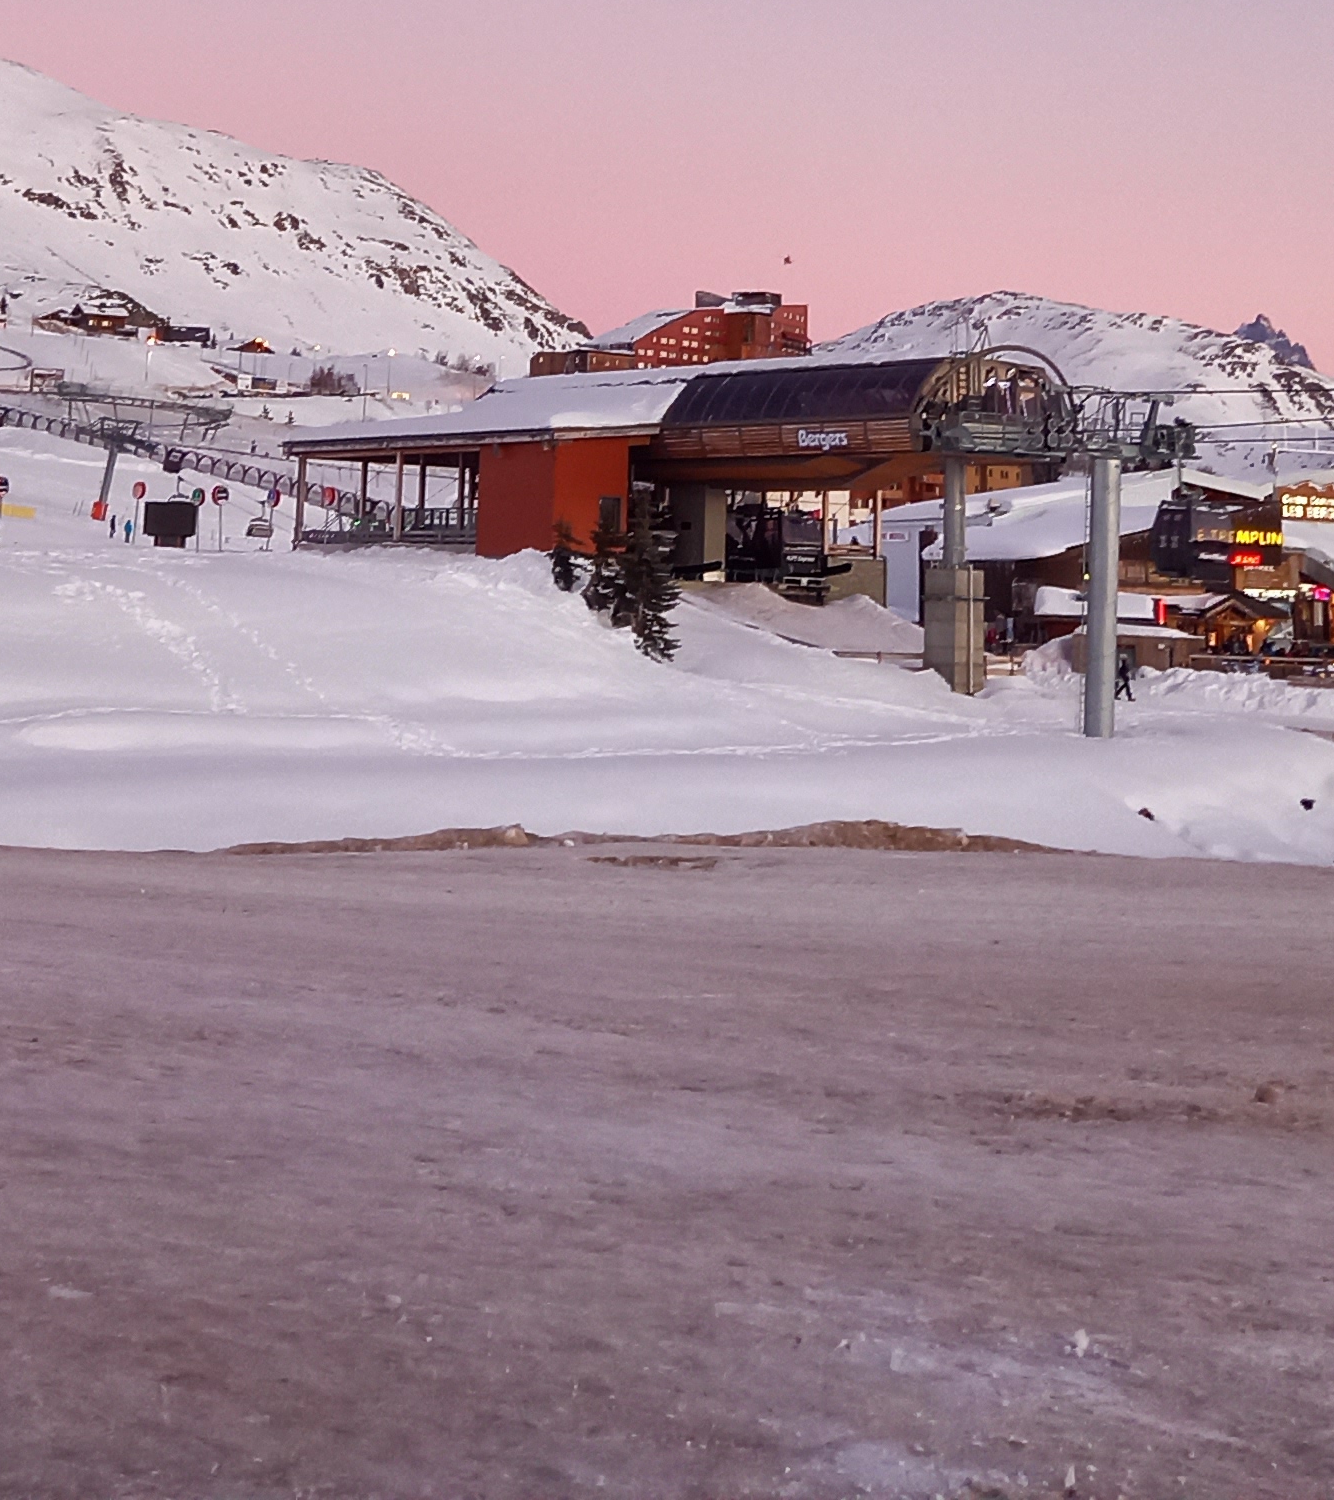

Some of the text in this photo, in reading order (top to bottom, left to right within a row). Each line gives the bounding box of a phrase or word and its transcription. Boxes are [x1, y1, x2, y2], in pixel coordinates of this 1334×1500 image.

[798, 429, 848, 451] Bergers
[1282, 504, 1304, 518] LES
[1210, 529, 1284, 546] TREMPLIN
